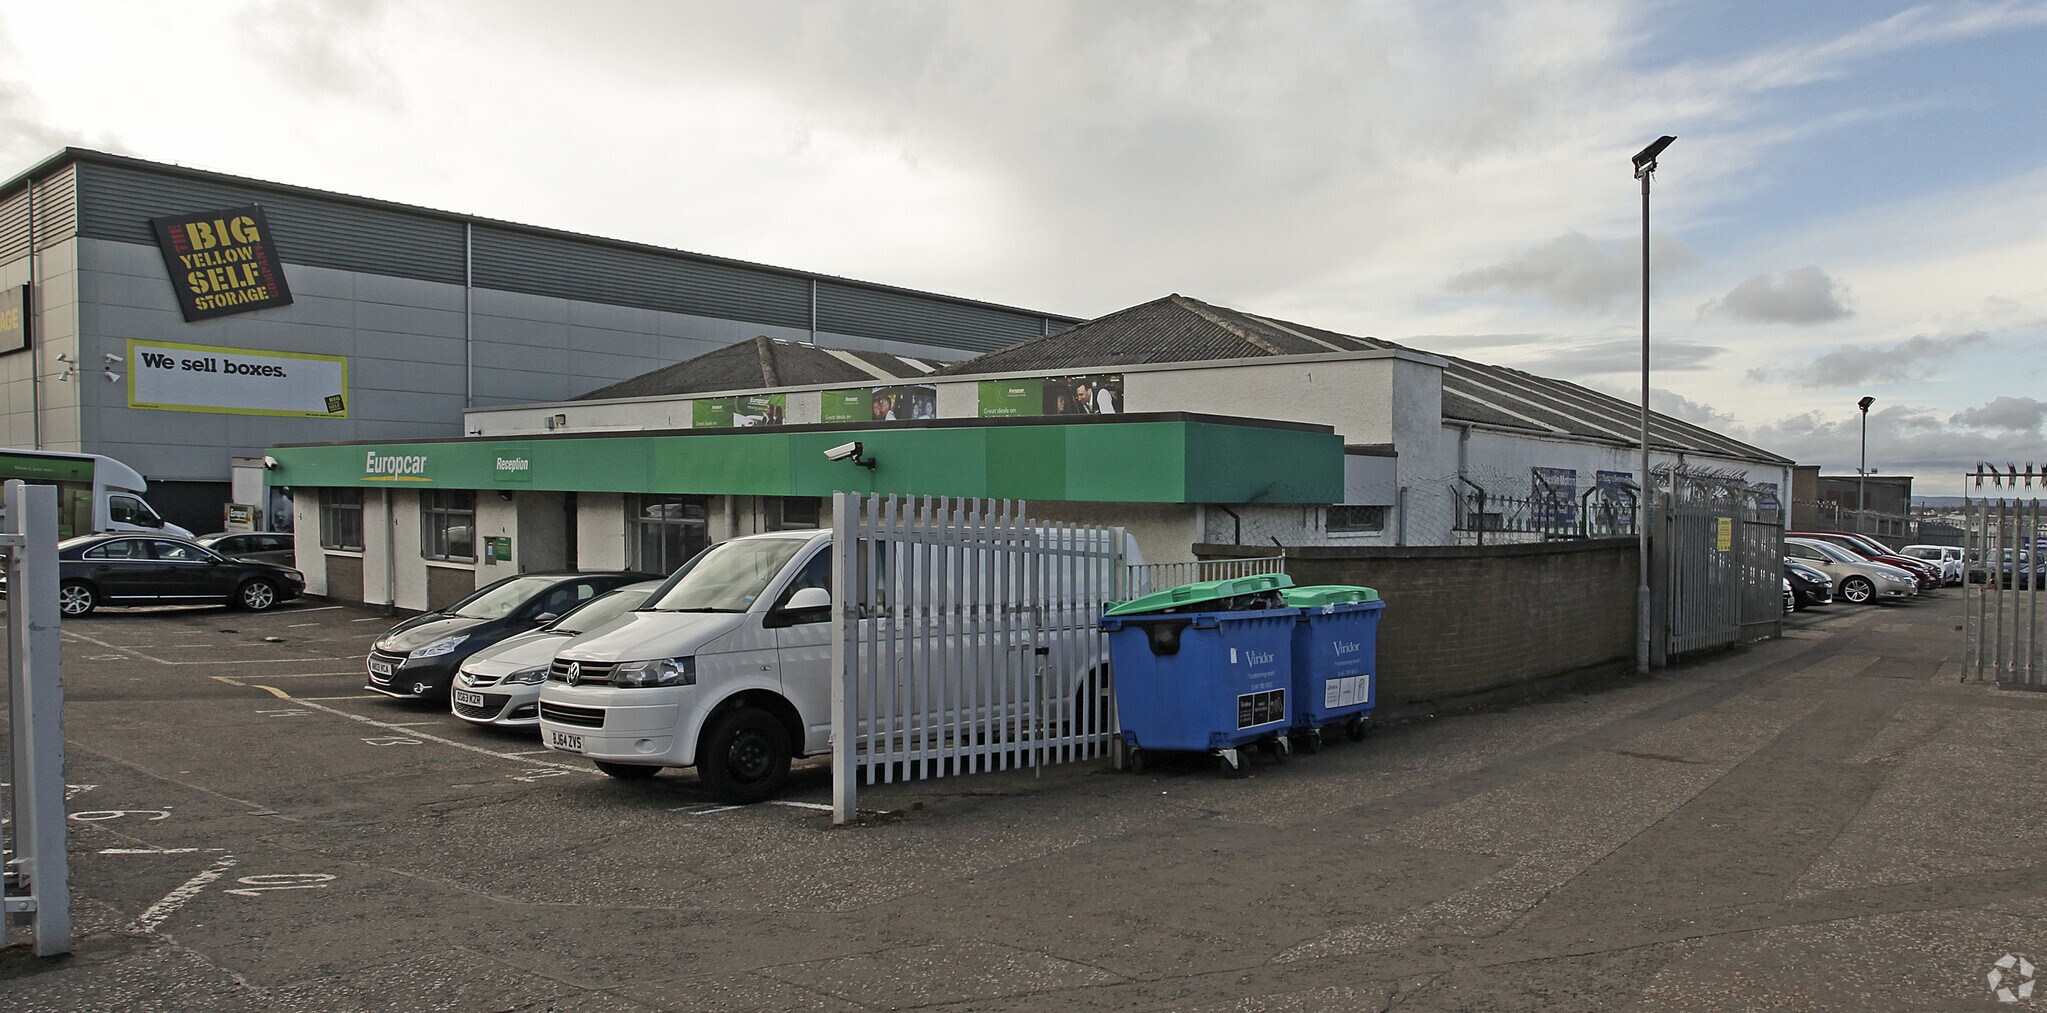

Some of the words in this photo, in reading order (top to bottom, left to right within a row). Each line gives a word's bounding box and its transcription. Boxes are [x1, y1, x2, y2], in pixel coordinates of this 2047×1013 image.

[185, 216, 260, 250] BIG
[179, 246, 253, 269] YELLOW
[188, 262, 259, 294] SELF
[194, 286, 269, 310] STORAGE
[141, 352, 175, 370] We
[181, 358, 217, 373] sell
[223, 359, 287, 378] boxes.
[366, 451, 427, 481] Europcar
[496, 457, 529, 473] Reception
[1245, 651, 1274, 668] Viridor
[1333, 641, 1360, 656] Viridor
